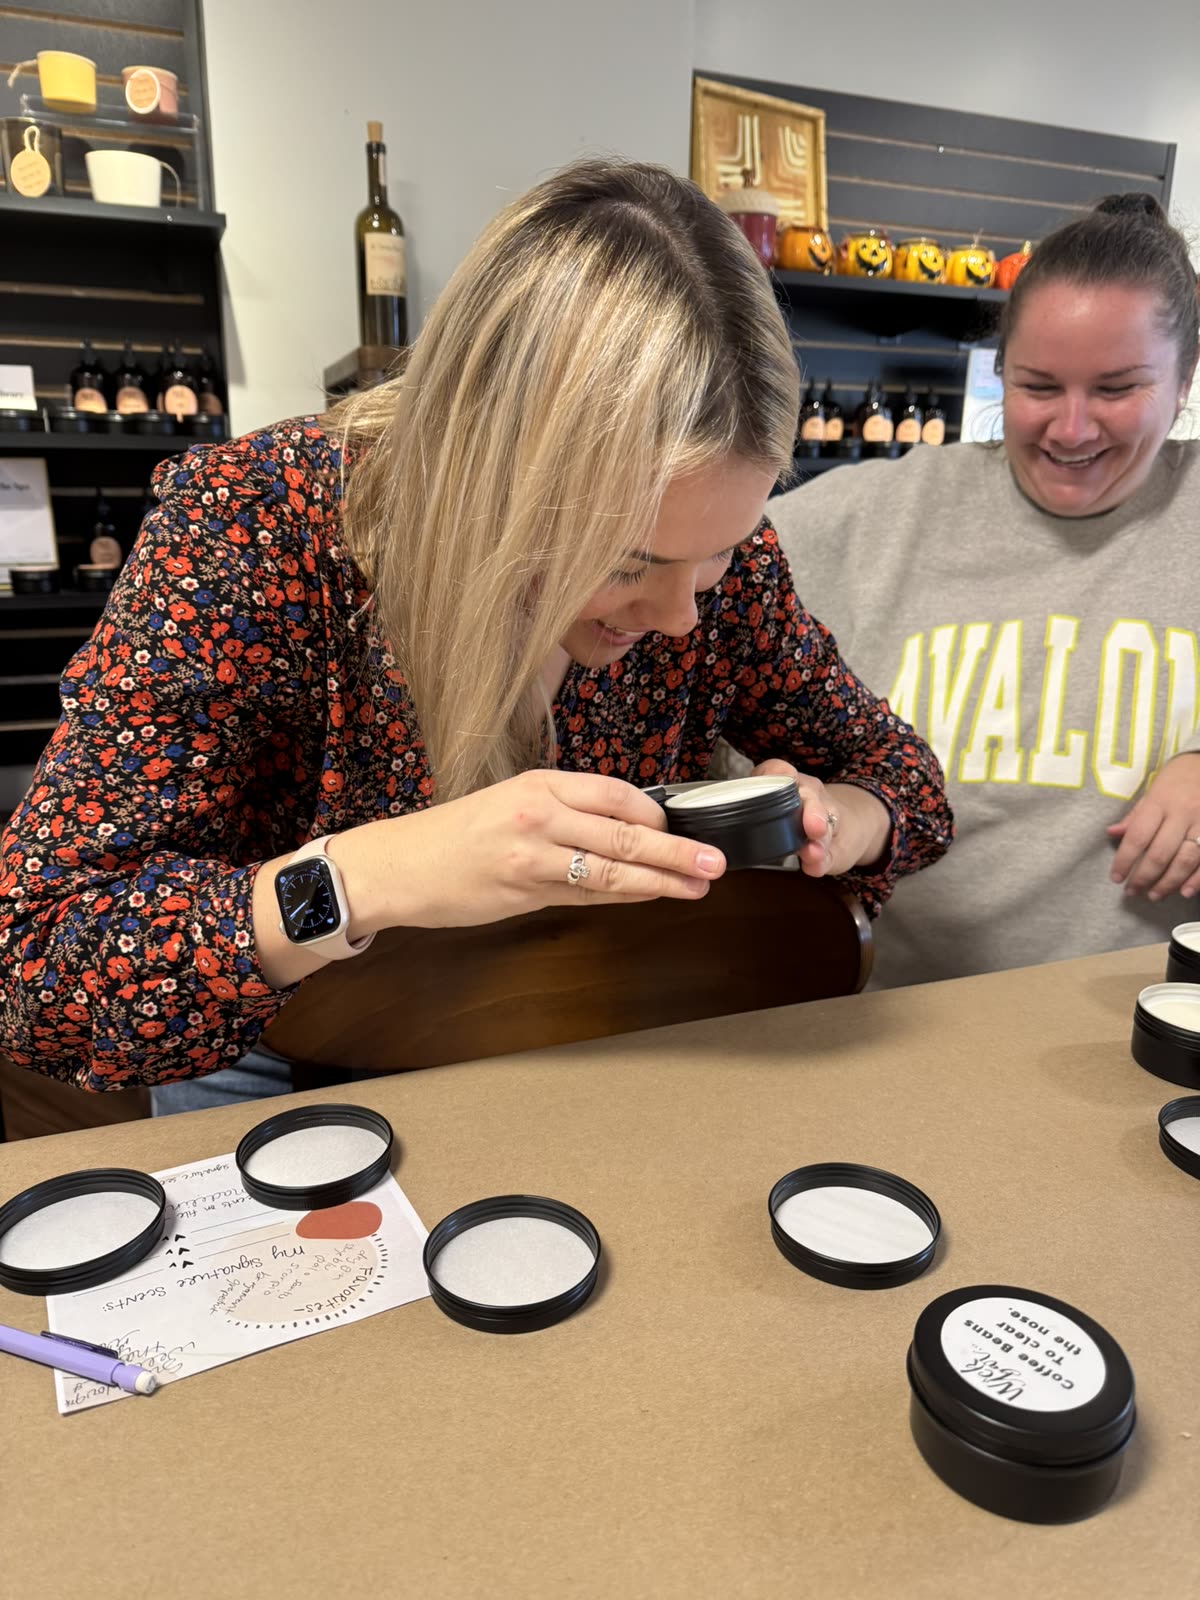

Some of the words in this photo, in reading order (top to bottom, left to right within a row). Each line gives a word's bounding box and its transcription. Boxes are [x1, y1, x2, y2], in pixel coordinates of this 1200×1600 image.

[963, 1318, 1014, 1353] Beans
[996, 1321, 1041, 1349] clear
[1008, 1307, 1050, 1336] nose.
[1045, 1349, 1064, 1366] To
[1053, 1335, 1082, 1356] the
[1017, 1352, 1075, 1391] Coffee
